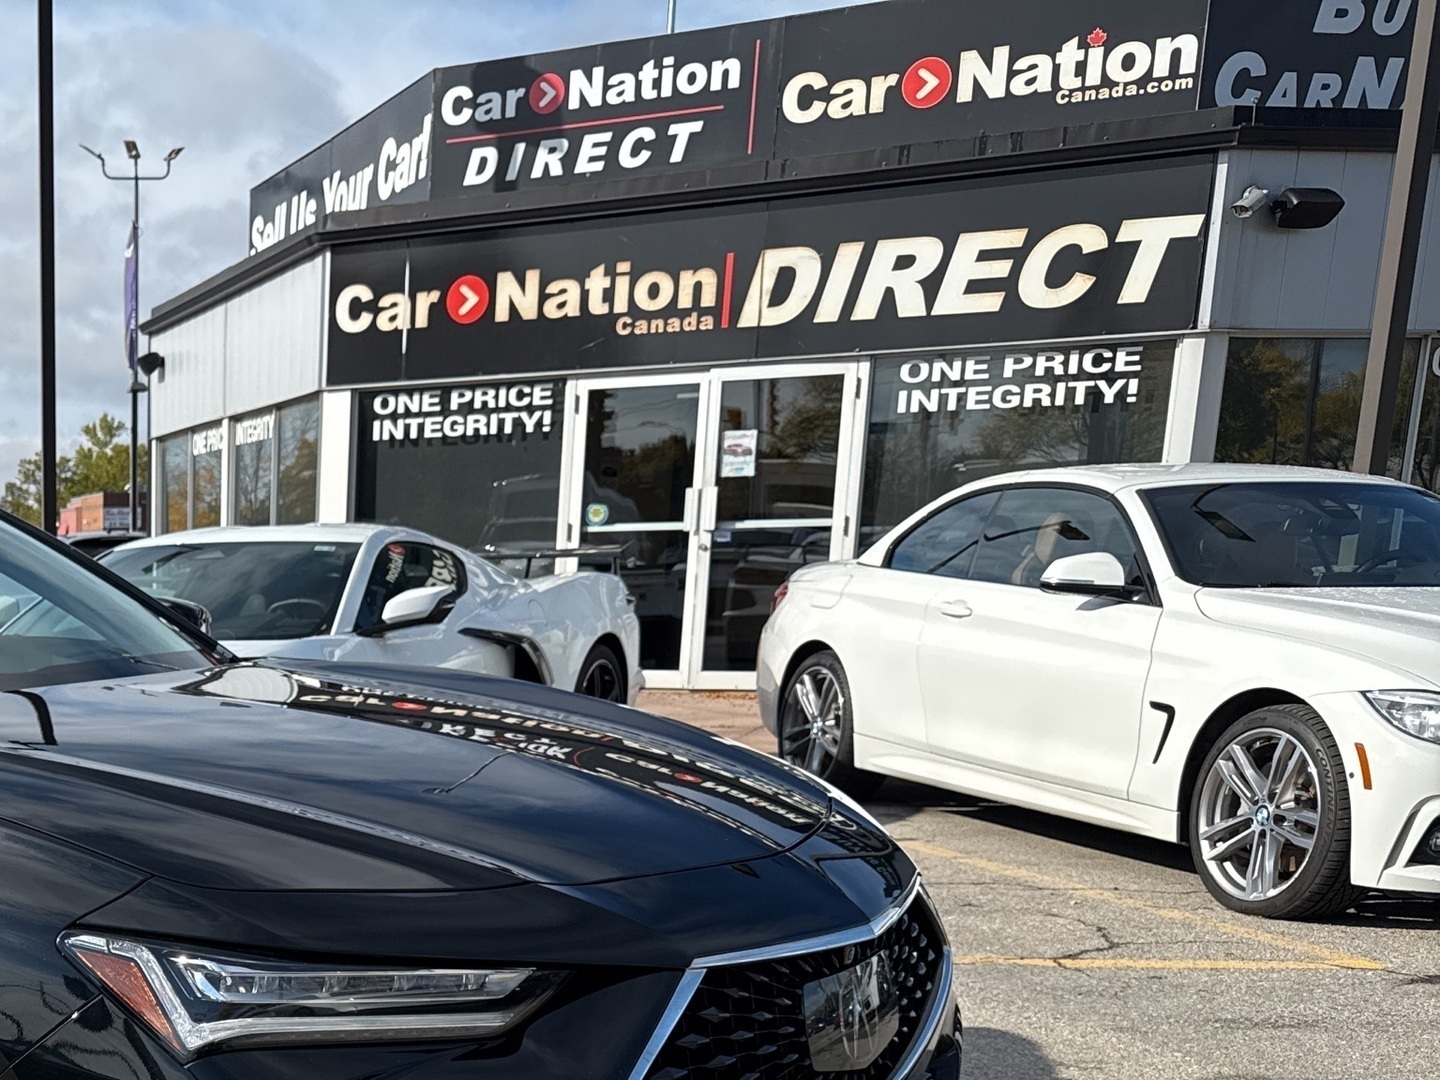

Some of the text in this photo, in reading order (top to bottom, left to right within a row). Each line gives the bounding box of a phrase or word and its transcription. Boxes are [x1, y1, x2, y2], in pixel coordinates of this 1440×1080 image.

[440, 56, 741, 126] Car Nation
[781, 28, 1198, 124] Car Nation
[1055, 75, 1194, 104] Canada.com
[322, 163, 374, 214] Your
[378, 113, 432, 200] Car!
[462, 120, 704, 187] DIRECT
[737, 214, 1206, 327] DIRECT
[335, 261, 717, 333] Car Nation
[615, 313, 714, 335] Canada
[899, 346, 1143, 384] ONE PRICE
[372, 383, 554, 415] ONE PRICE
[896, 378, 1139, 414] INTEGRITY!
[372, 410, 552, 441] INTEGRITY!
